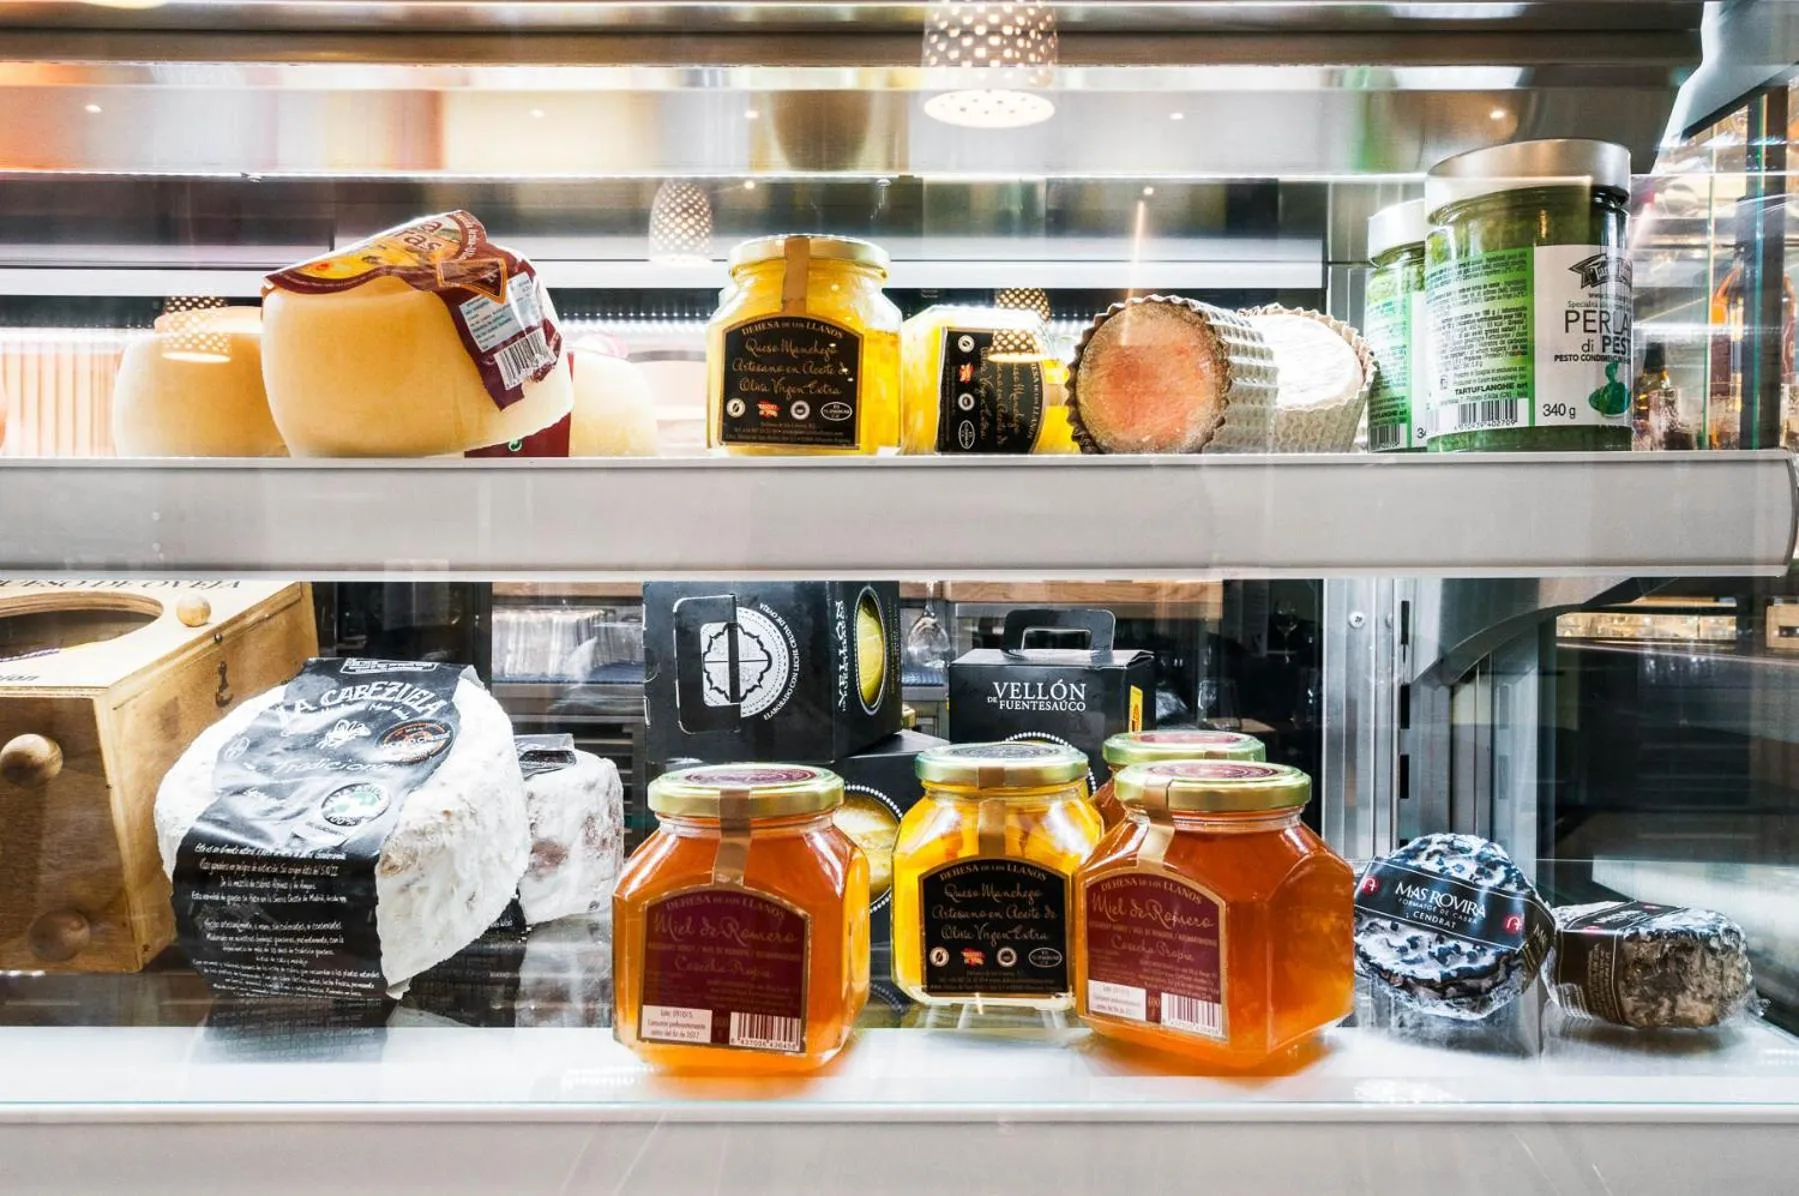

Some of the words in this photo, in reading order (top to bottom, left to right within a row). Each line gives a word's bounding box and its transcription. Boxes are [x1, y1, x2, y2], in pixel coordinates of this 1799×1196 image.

[745, 338, 777, 358] Queso
[1581, 338, 1594, 353] di
[1554, 354, 1579, 362] PESTO
[1542, 402, 1566, 417] 340
[1569, 407, 1577, 420] g
[320, 680, 448, 718] CABEZUELA
[992, 678, 1086, 701] VELLÓN
[999, 700, 1087, 712] FUENTESAÚCO
[939, 863, 979, 881] DEHESA
[1007, 864, 1047, 881] LLANOS
[944, 883, 979, 903] Queso
[981, 882, 1043, 904] Manchego
[1100, 877, 1137, 893] DEHESA
[1163, 881, 1203, 905] LLANOS
[1395, 881, 1429, 901] MAS
[1429, 890, 1486, 919] ROVIRA
[932, 904, 987, 919] Artesano
[1005, 904, 1041, 920] Aceite
[1091, 892, 1127, 922] Miel
[1129, 899, 1147, 919] de
[1145, 898, 1214, 929] Romero
[1413, 910, 1457, 929] CENDRAT
[653, 912, 696, 942] Miel
[718, 914, 799, 948] Romero
[974, 922, 1009, 948] Virgen
[1008, 924, 1049, 940] Extra
